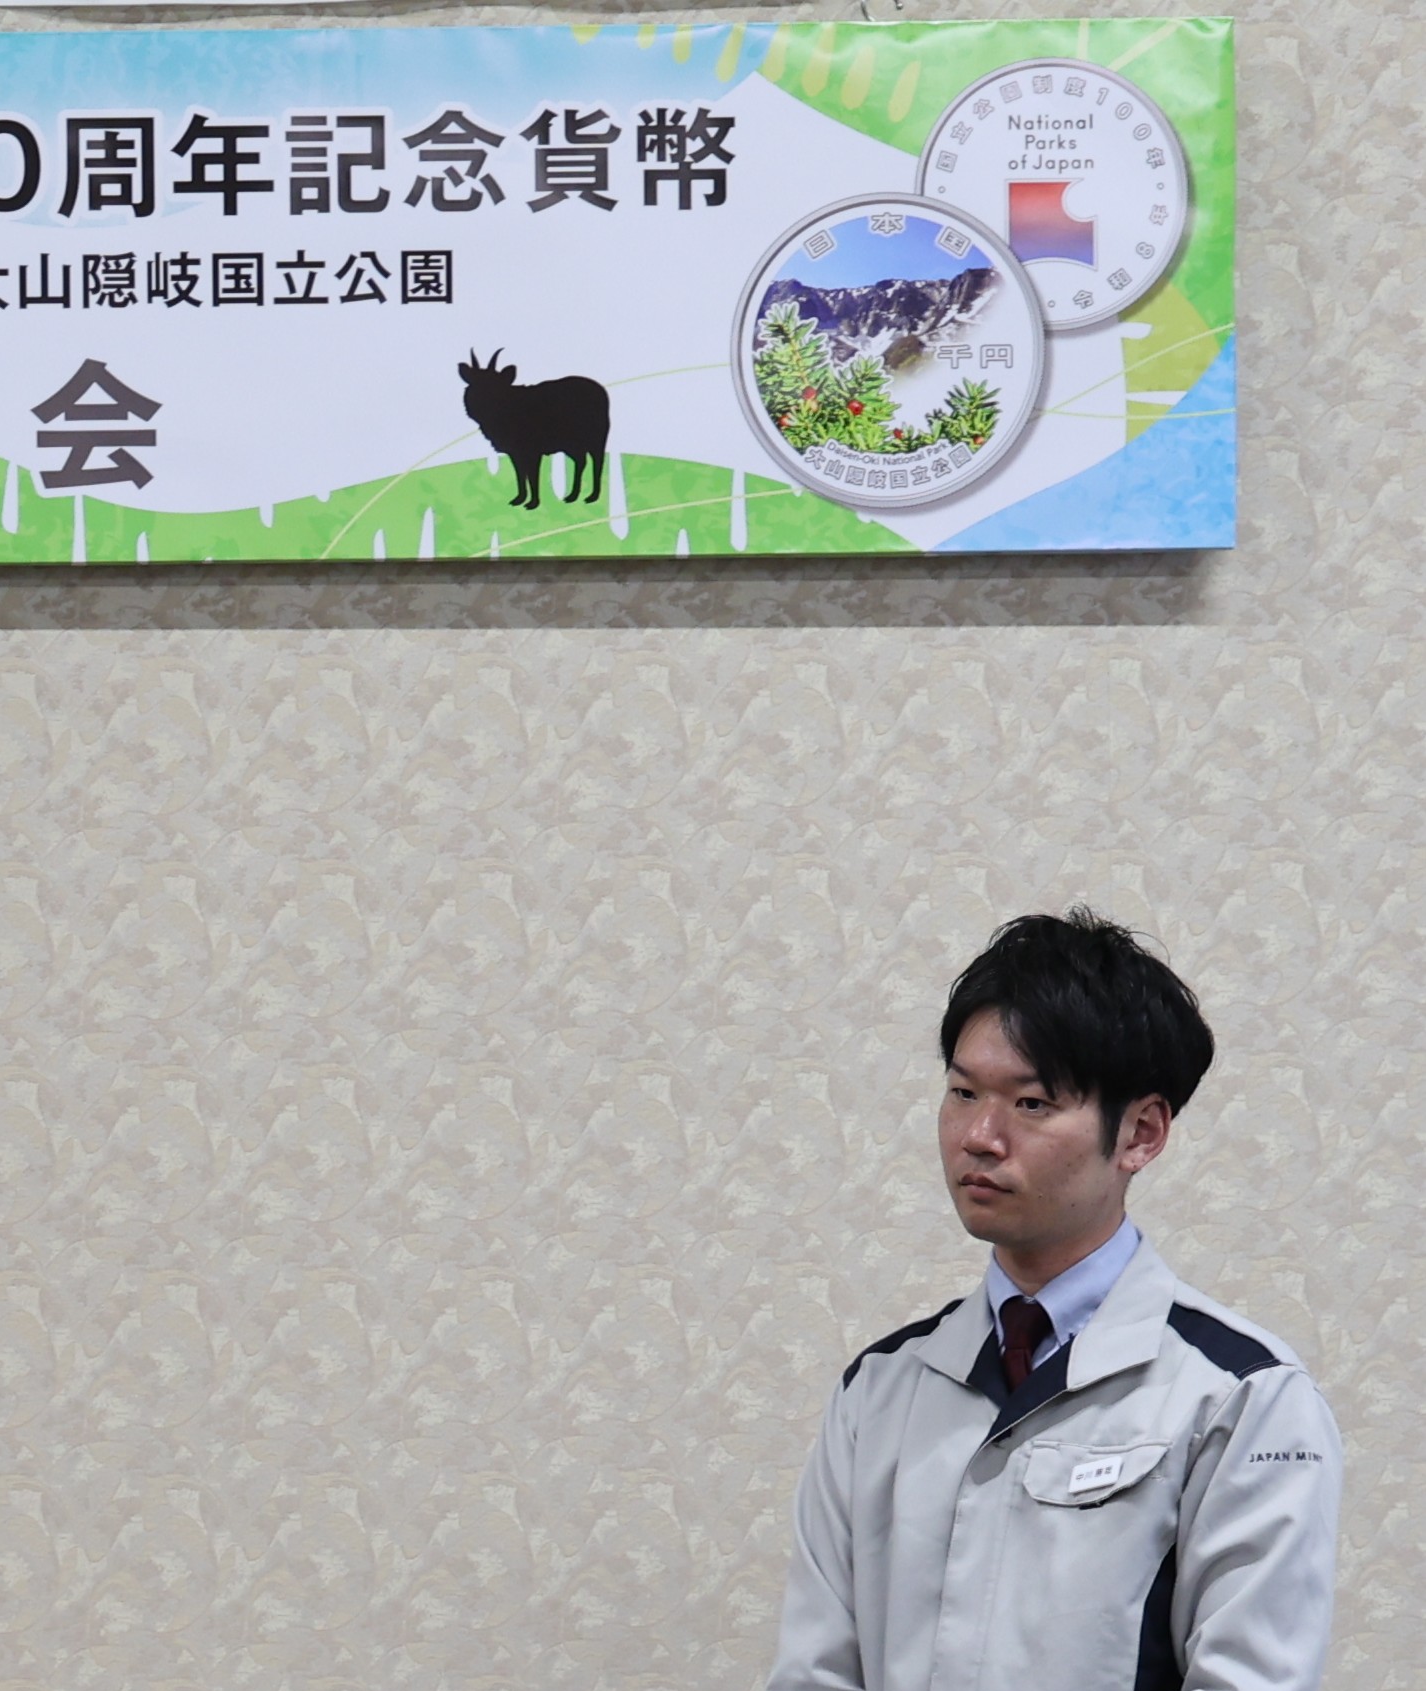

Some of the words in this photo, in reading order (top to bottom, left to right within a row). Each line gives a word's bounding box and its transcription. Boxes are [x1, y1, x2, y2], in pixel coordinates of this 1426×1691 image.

[1007, 114, 1094, 131] National
[1024, 134, 1077, 150] Parks
[1008, 154, 1028, 170] of
[1032, 155, 1094, 174] Japan
[803, 212, 972, 260] 日本国
[936, 343, 1014, 369] 千円
[883, 452, 924, 466] National
[926, 442, 948, 457] Park
[1249, 1452, 1290, 1463] JAPAN
